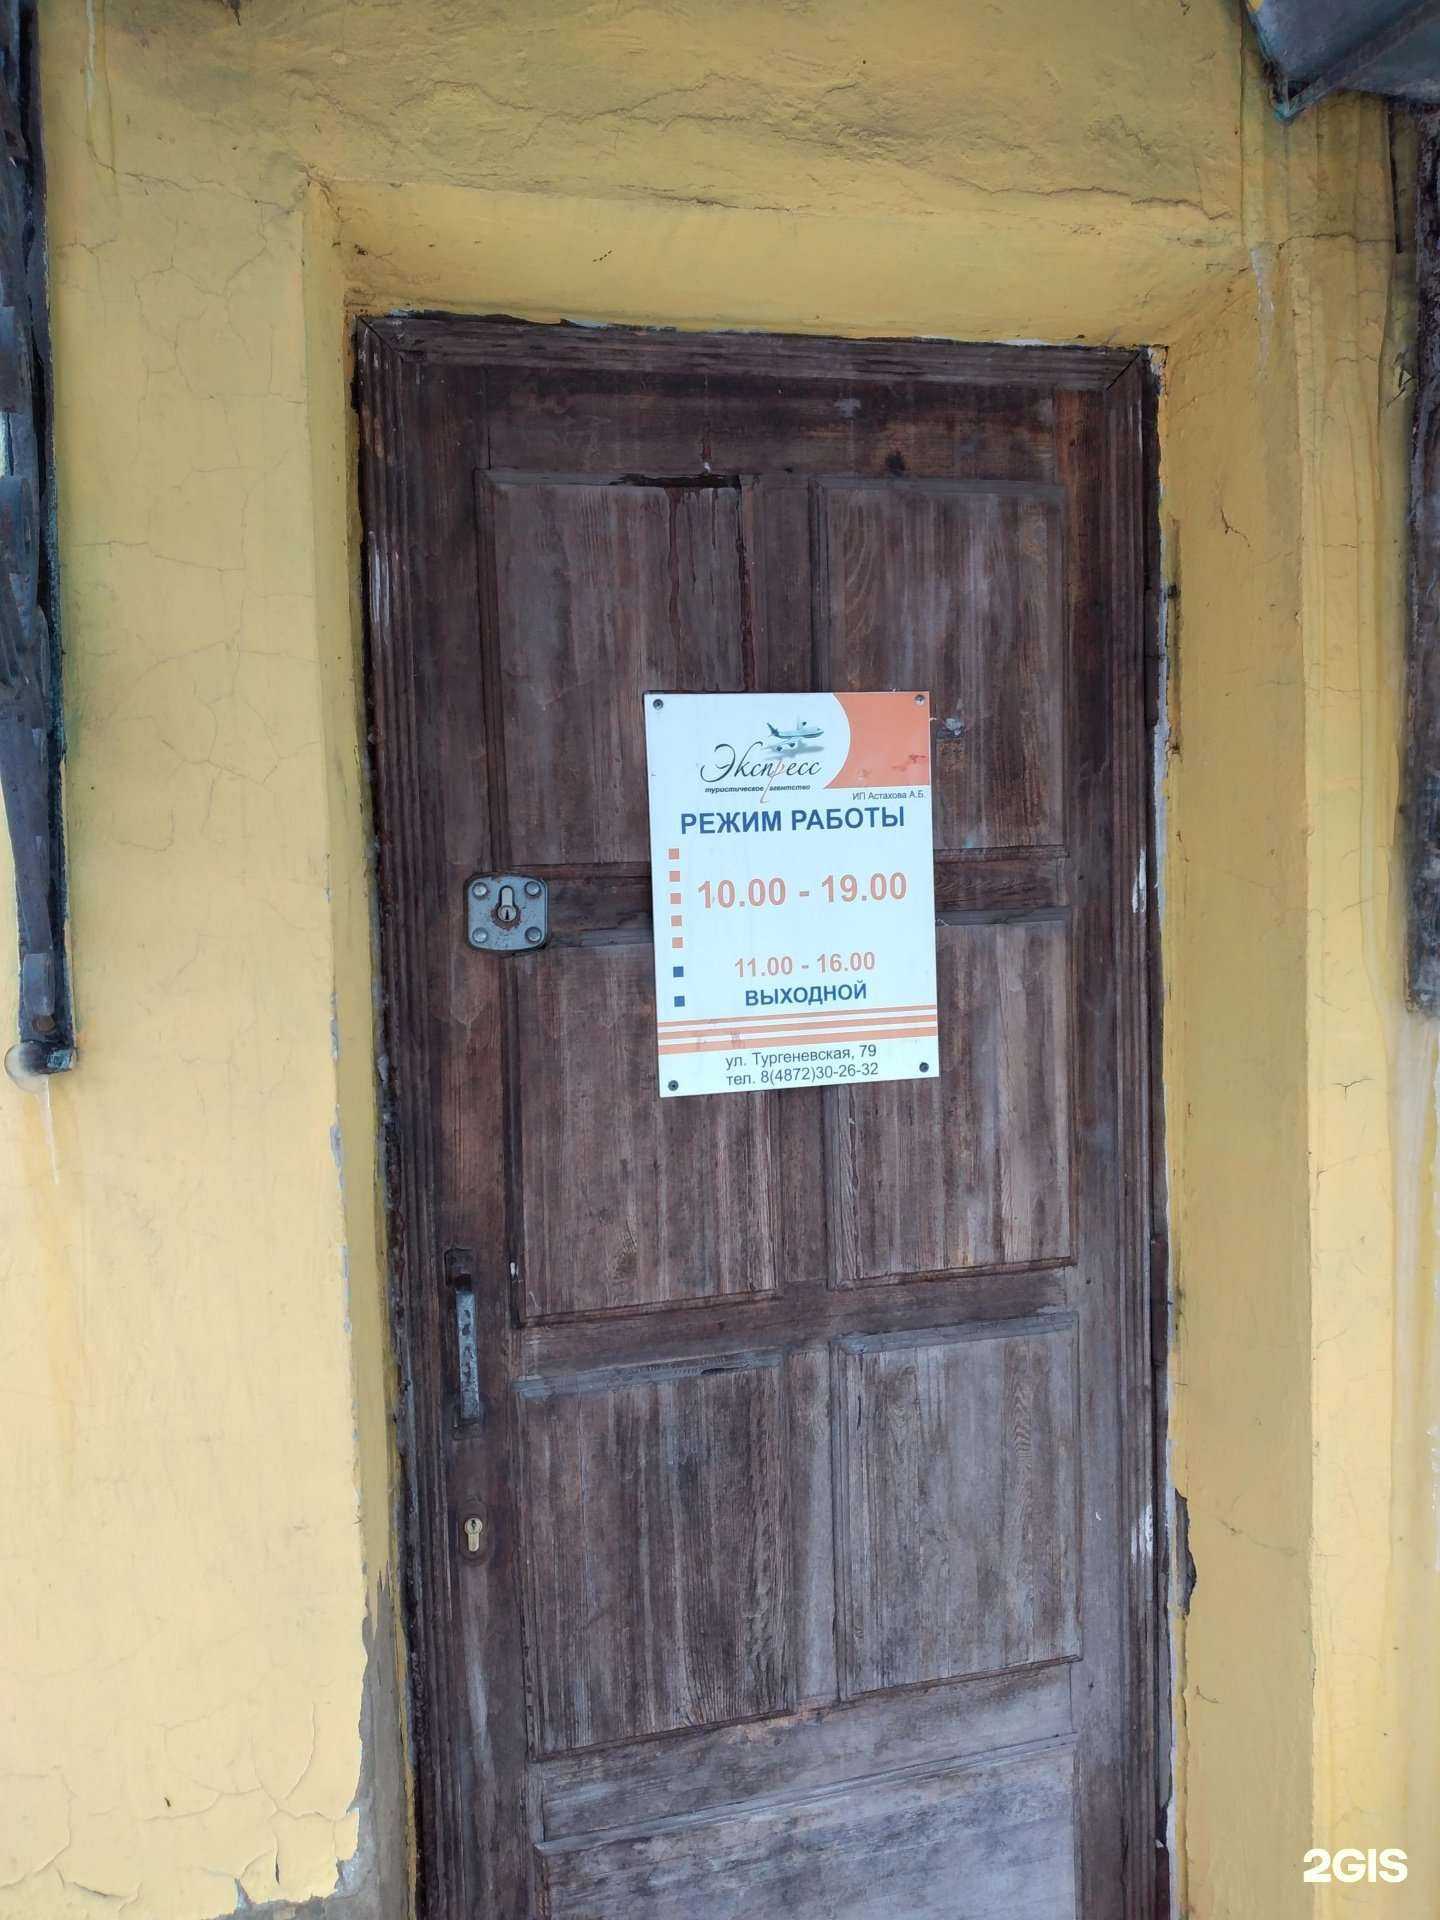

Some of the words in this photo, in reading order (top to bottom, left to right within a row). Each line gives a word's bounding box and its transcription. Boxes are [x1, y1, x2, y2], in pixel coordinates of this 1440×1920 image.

[852, 791, 866, 801] ИП
[868, 790, 907, 801] Астахова
[680, 810, 782, 835] РЕЖИМ
[791, 805, 905, 831] РАБОТЫ
[697, 877, 787, 909] 10.00
[821, 872, 907, 904] 19.00
[734, 956, 793, 978] 11.00
[816, 951, 876, 973] 16.00
[745, 980, 867, 1007] ВЫХОДНОЙ
[725, 1056, 747, 1070] ул.
[752, 1048, 855, 1069] Тургеневская,
[859, 1044, 877, 1058] 79
[726, 1073, 755, 1086] тел.
[760, 1062, 879, 1086] 8(4872)30-26-32
